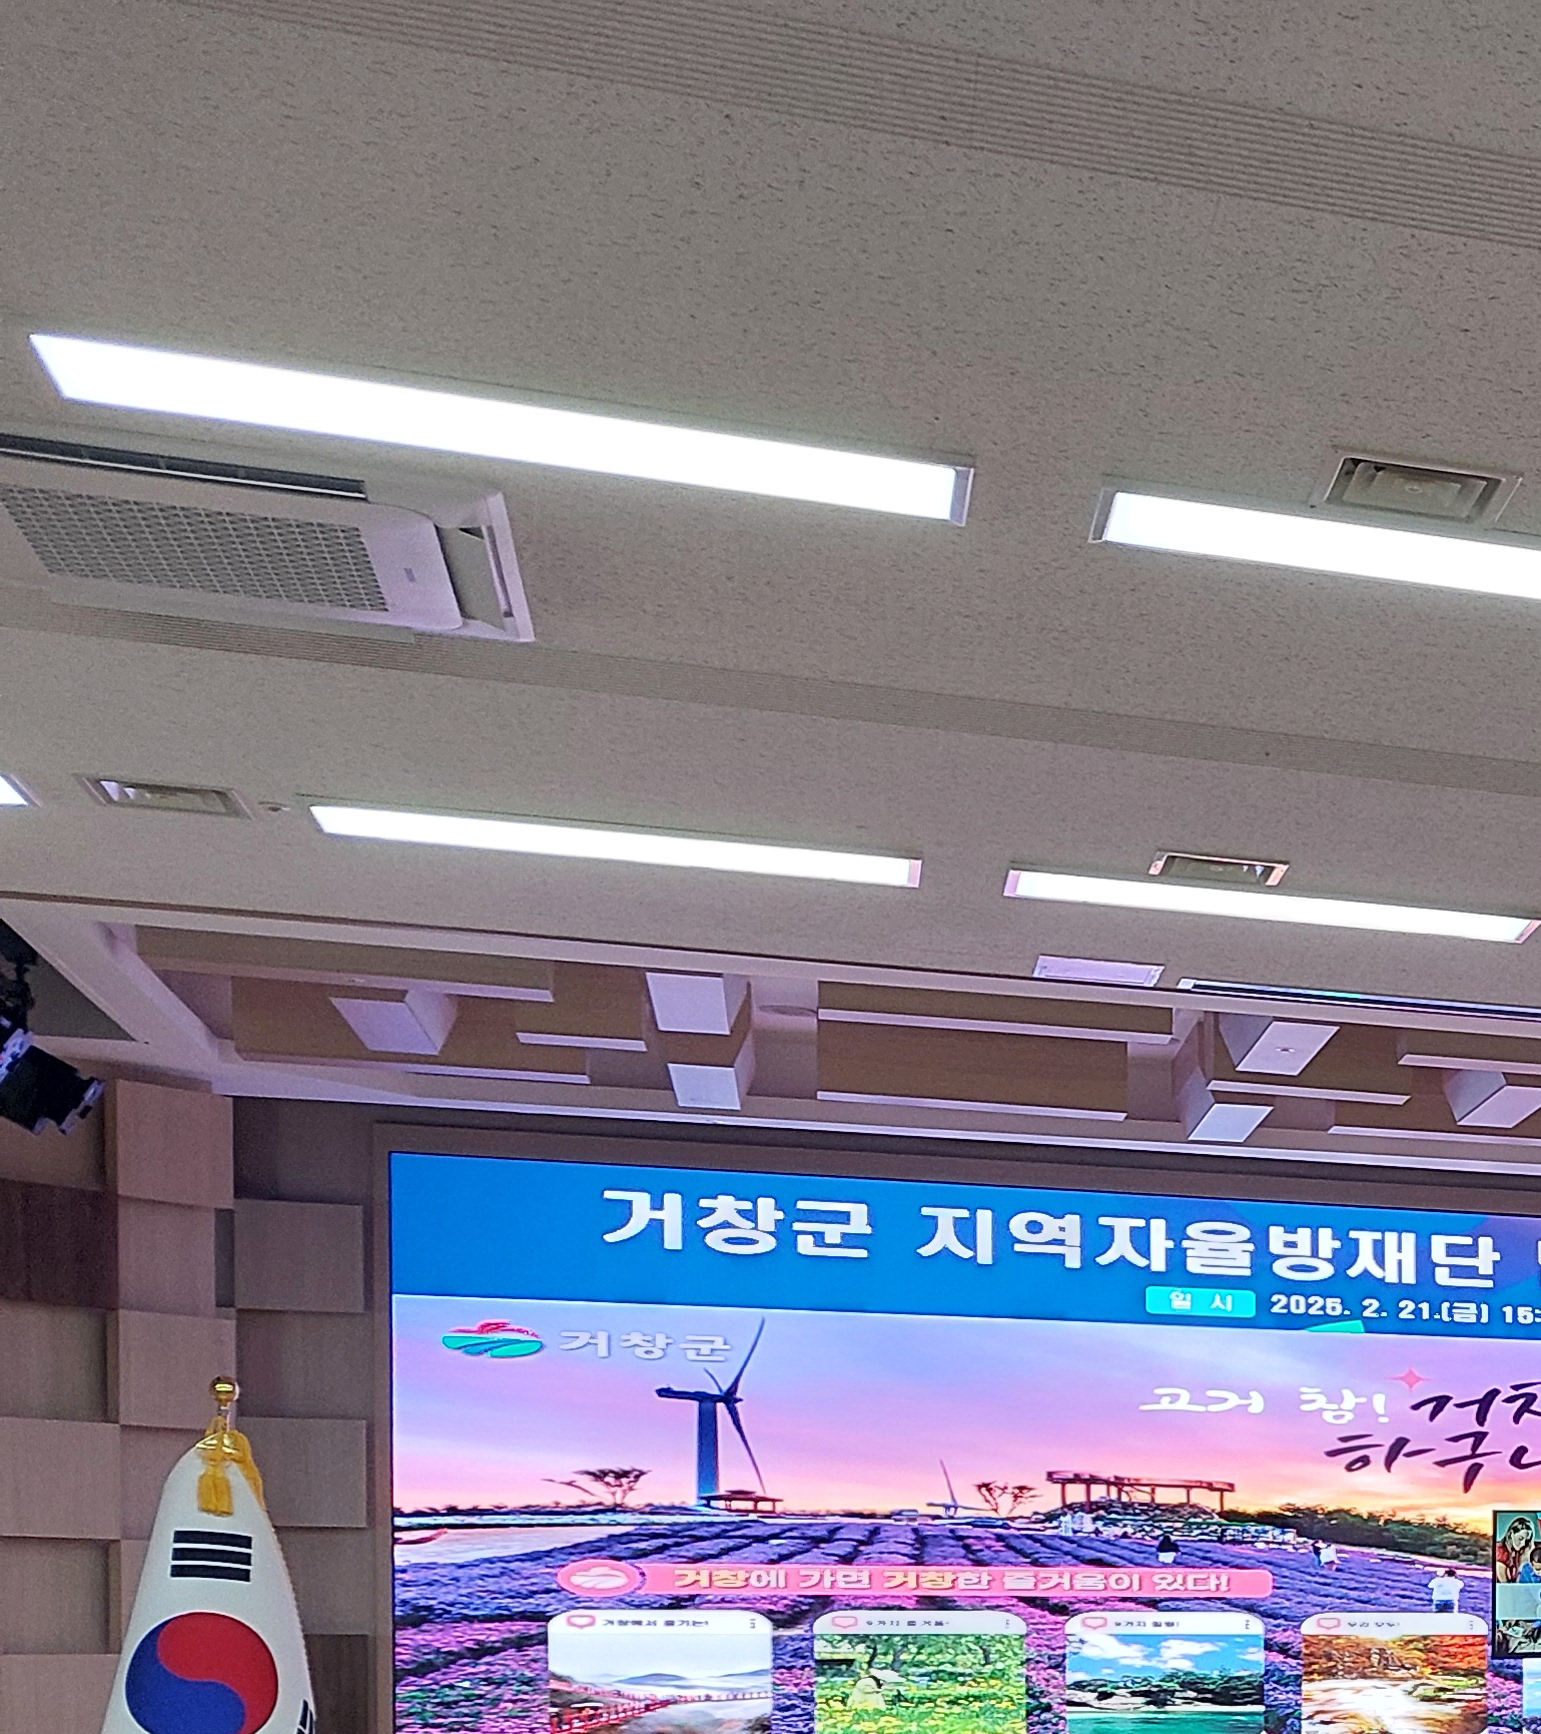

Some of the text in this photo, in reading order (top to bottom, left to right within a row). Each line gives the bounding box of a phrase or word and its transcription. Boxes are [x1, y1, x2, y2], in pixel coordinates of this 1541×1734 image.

[602, 1190, 873, 1258] 거창군
[916, 1206, 1501, 1289] 지역자율방재단
[559, 1328, 732, 1363] 거창군
[1138, 1386, 1266, 1415] 고거
[674, 1568, 1231, 1593] 거창에 가면 거창한 즐거움이 있다!
